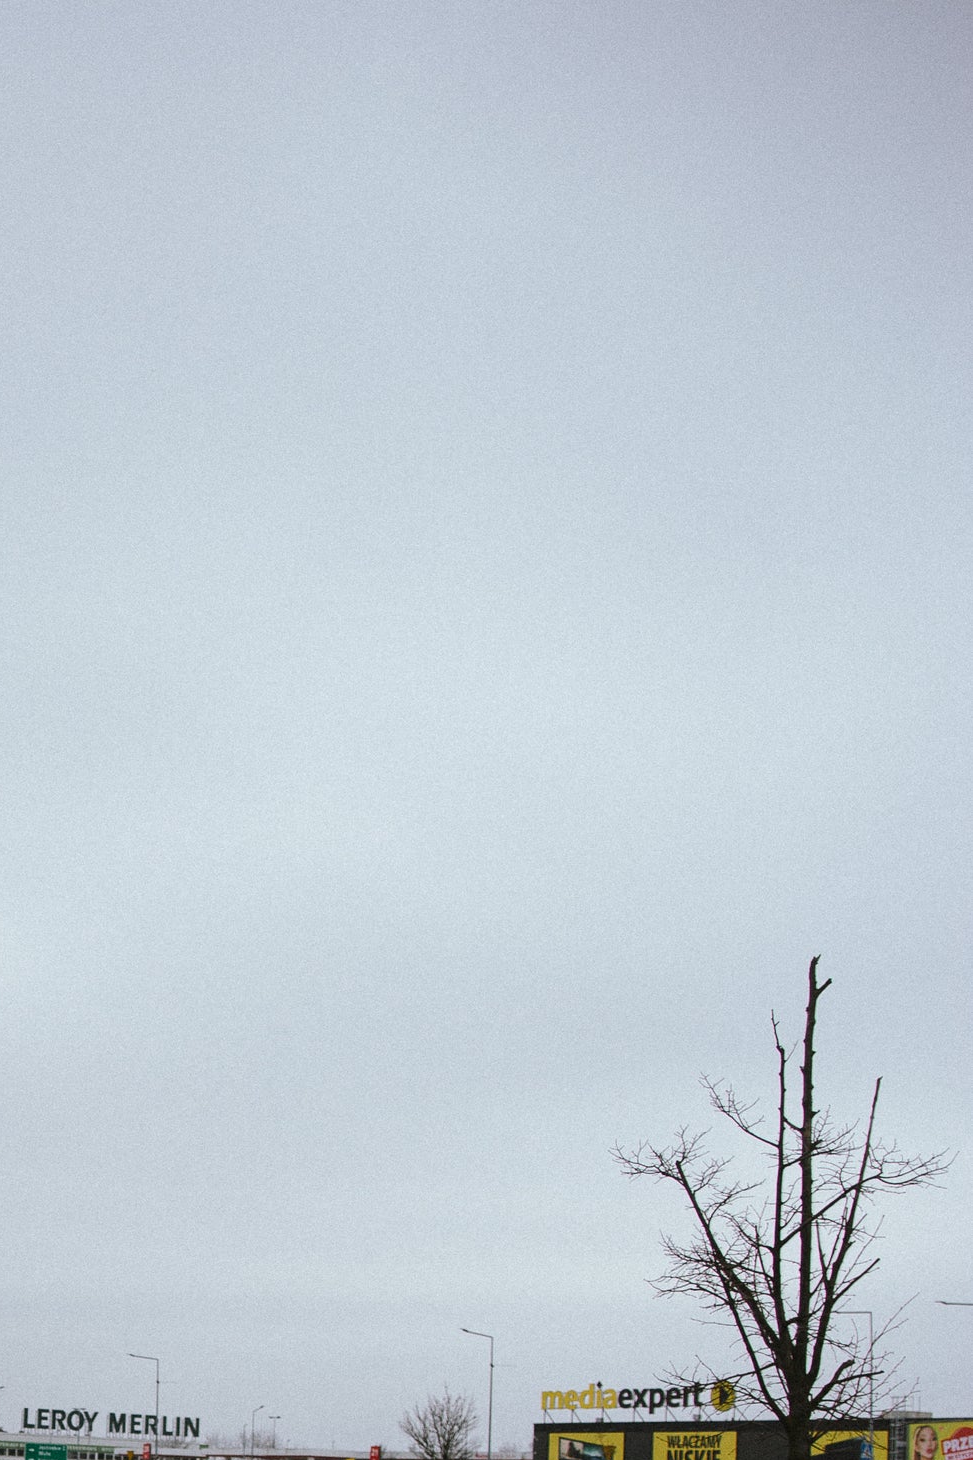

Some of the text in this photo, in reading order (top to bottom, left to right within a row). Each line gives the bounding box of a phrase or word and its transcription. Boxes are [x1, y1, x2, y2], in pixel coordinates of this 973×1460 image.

[541, 1382, 704, 1414] mediaexpert
[22, 1407, 200, 1438] LEROY MERLIN
